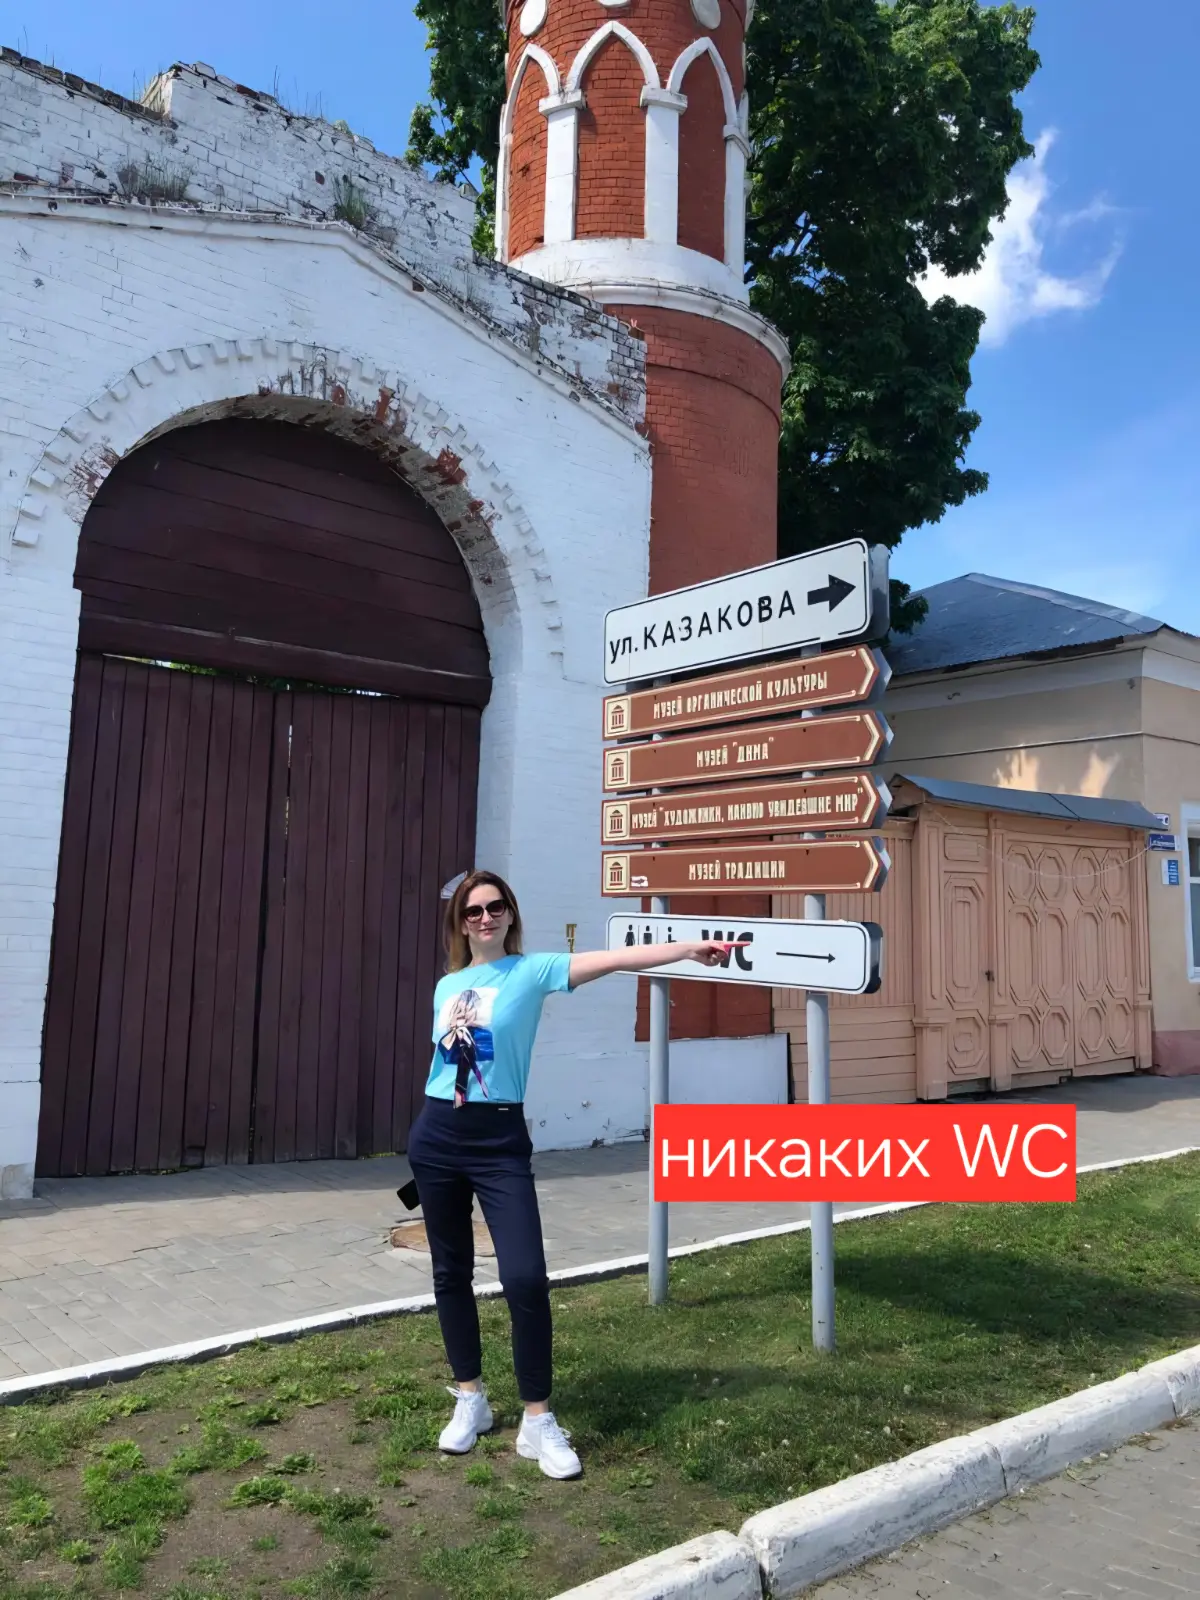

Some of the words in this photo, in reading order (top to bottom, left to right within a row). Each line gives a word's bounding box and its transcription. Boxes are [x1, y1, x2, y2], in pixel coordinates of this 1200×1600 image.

[653, 696, 682, 719] МУЗЕЙ
[687, 681, 762, 713] ОРГАНИЧЕСКОЙ
[767, 671, 828, 699] КУЛЬТУРЫ
[696, 745, 728, 768] МУЗЕЙ
[631, 808, 657, 829] МУЗЕЙ
[727, 802, 764, 821] НАИВНО
[768, 796, 831, 818] УВИДЕВШИЕ
[689, 859, 721, 880] МУЗЕЙ
[725, 860, 785, 880] ТРАДИЦИИ
